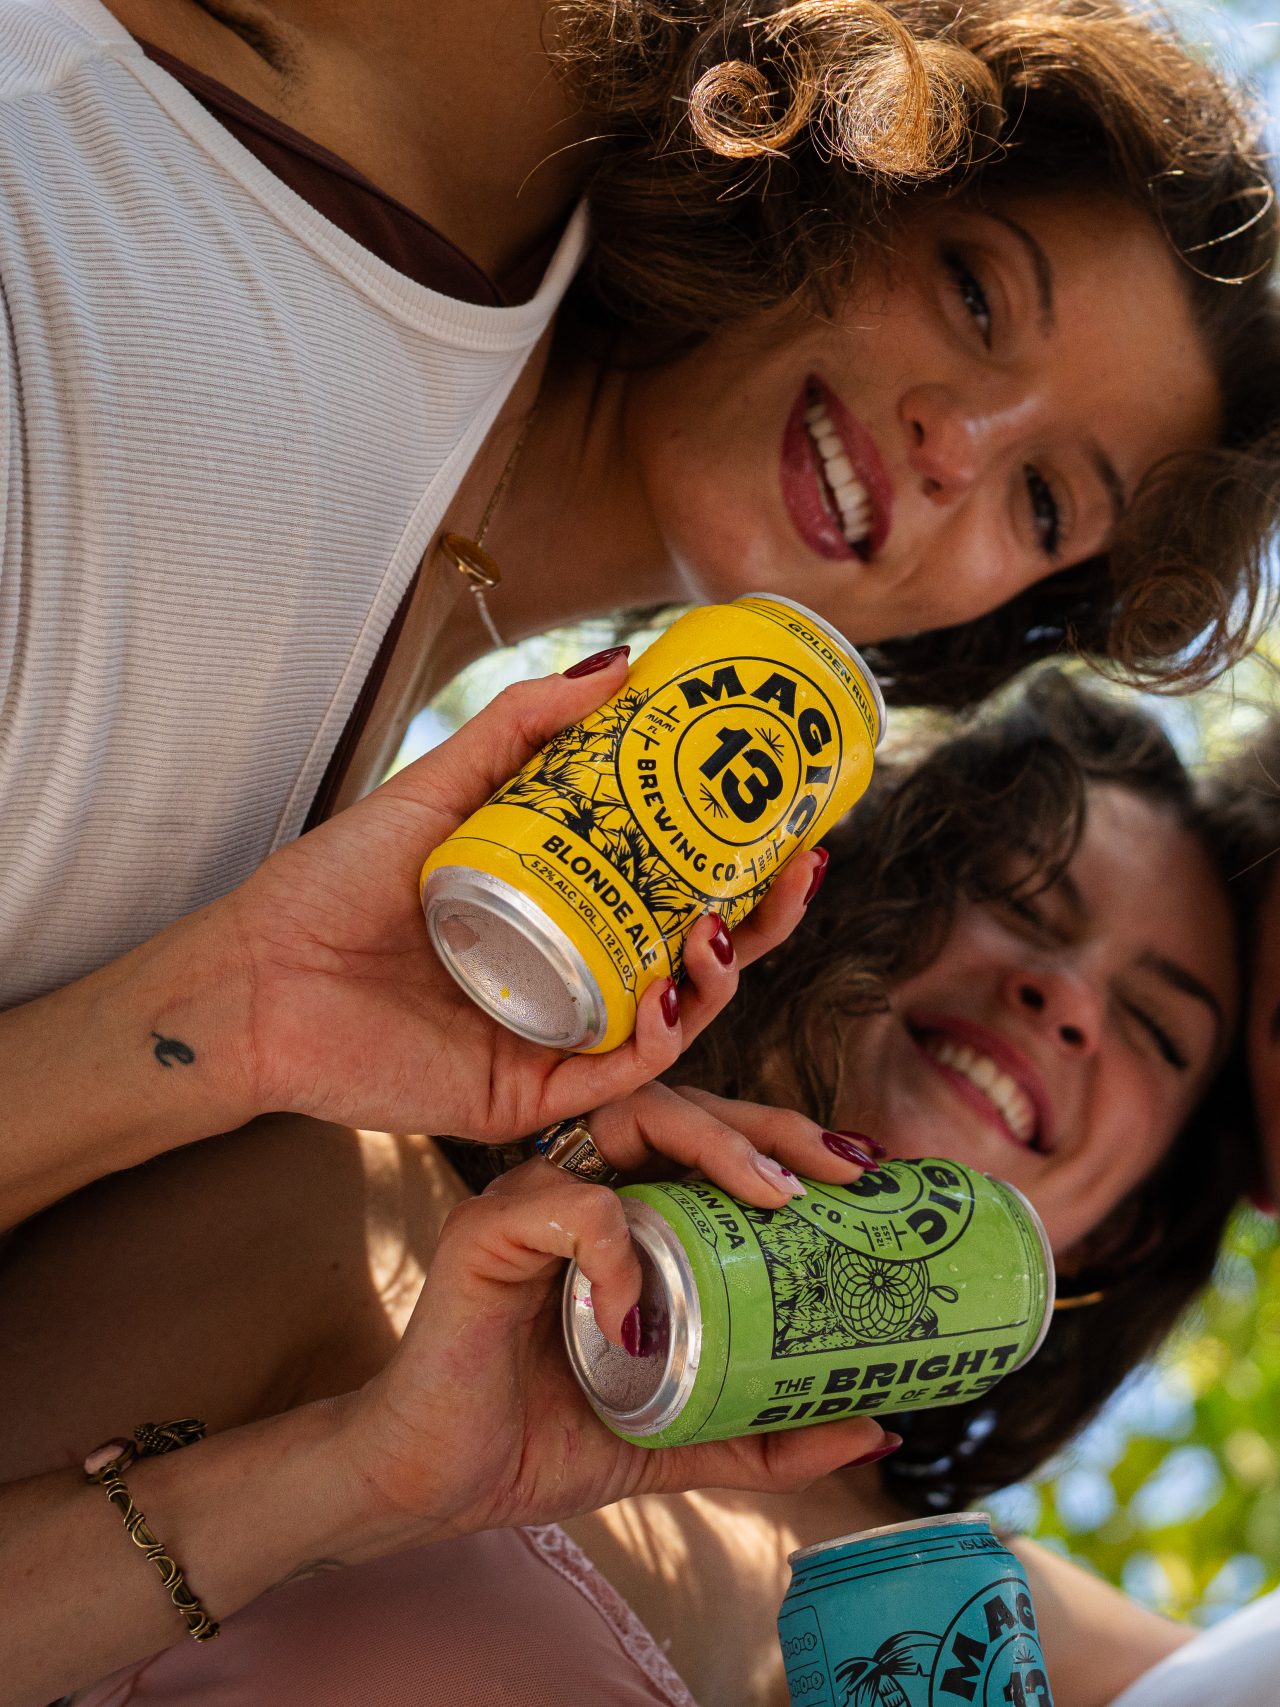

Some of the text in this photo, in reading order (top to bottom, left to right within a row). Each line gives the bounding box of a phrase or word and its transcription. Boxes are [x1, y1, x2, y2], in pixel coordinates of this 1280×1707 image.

[788, 622, 876, 738] GOLDEN RULES
[644, 713, 676, 733] MIAMI
[647, 725, 658, 735] FL
[677, 665, 833, 839] MAGIC
[698, 726, 784, 824] 13
[637, 758, 739, 882] BREWING CO.
[530, 859, 555, 882] 5.2%
[553, 878, 577, 903] ALC.
[578, 900, 598, 927] VOL.
[604, 933, 616, 947] 12
[541, 834, 658, 972] BLONDE ALE
[842, 1170, 901, 1198] 3
[905, 1160, 963, 1246] GIC
[681, 1182, 746, 1250] CAN IPA
[810, 1202, 848, 1229] CO.
[871, 1225, 885, 1249] 2021
[880, 1225, 894, 1249] EST.
[749, 1373, 1008, 1427] SIDE OF 13
[773, 1343, 1020, 1396] THE BRIGHT
[957, 1537, 1007, 1551] ISLAN
[939, 1592, 1037, 1703] MAG
